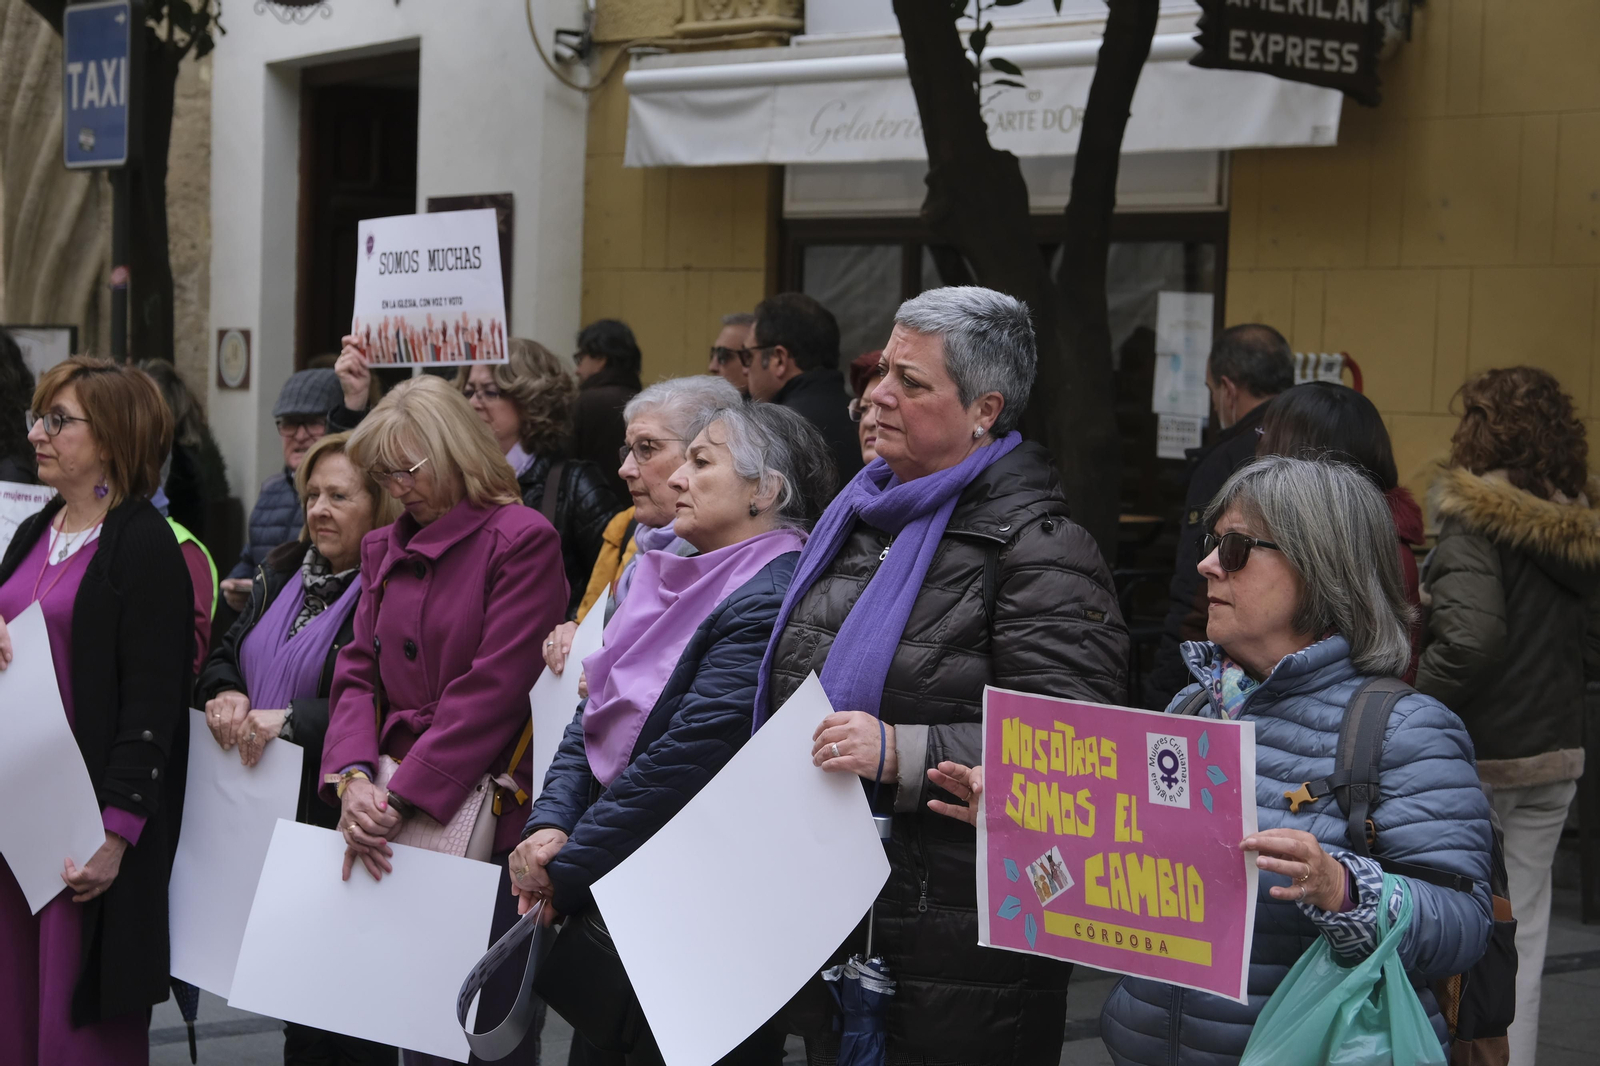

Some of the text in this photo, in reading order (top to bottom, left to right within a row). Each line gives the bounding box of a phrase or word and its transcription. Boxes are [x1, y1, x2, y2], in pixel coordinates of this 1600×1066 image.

[1229, 29, 1359, 74] EXPRESS
[67, 57, 126, 110] TAXI
[379, 246, 482, 275] SOMOS MUCHAS
[382, 299, 389, 309] EN
[390, 299, 396, 309] LA
[419, 297, 431, 308] CON
[432, 296, 442, 307] VOZ
[448, 296, 463, 306] VOTO
[3, 489, 32, 503] mujeres
[1002, 717, 1117, 780] NOSOTRAS
[1149, 736, 1187, 803] Mujeres Cristianas en la Iglesia
[1005, 773, 1143, 843] SOMOS EL
[1085, 852, 1205, 923] CAMBIO
[1074, 922, 1169, 954] CÓRDOBA
